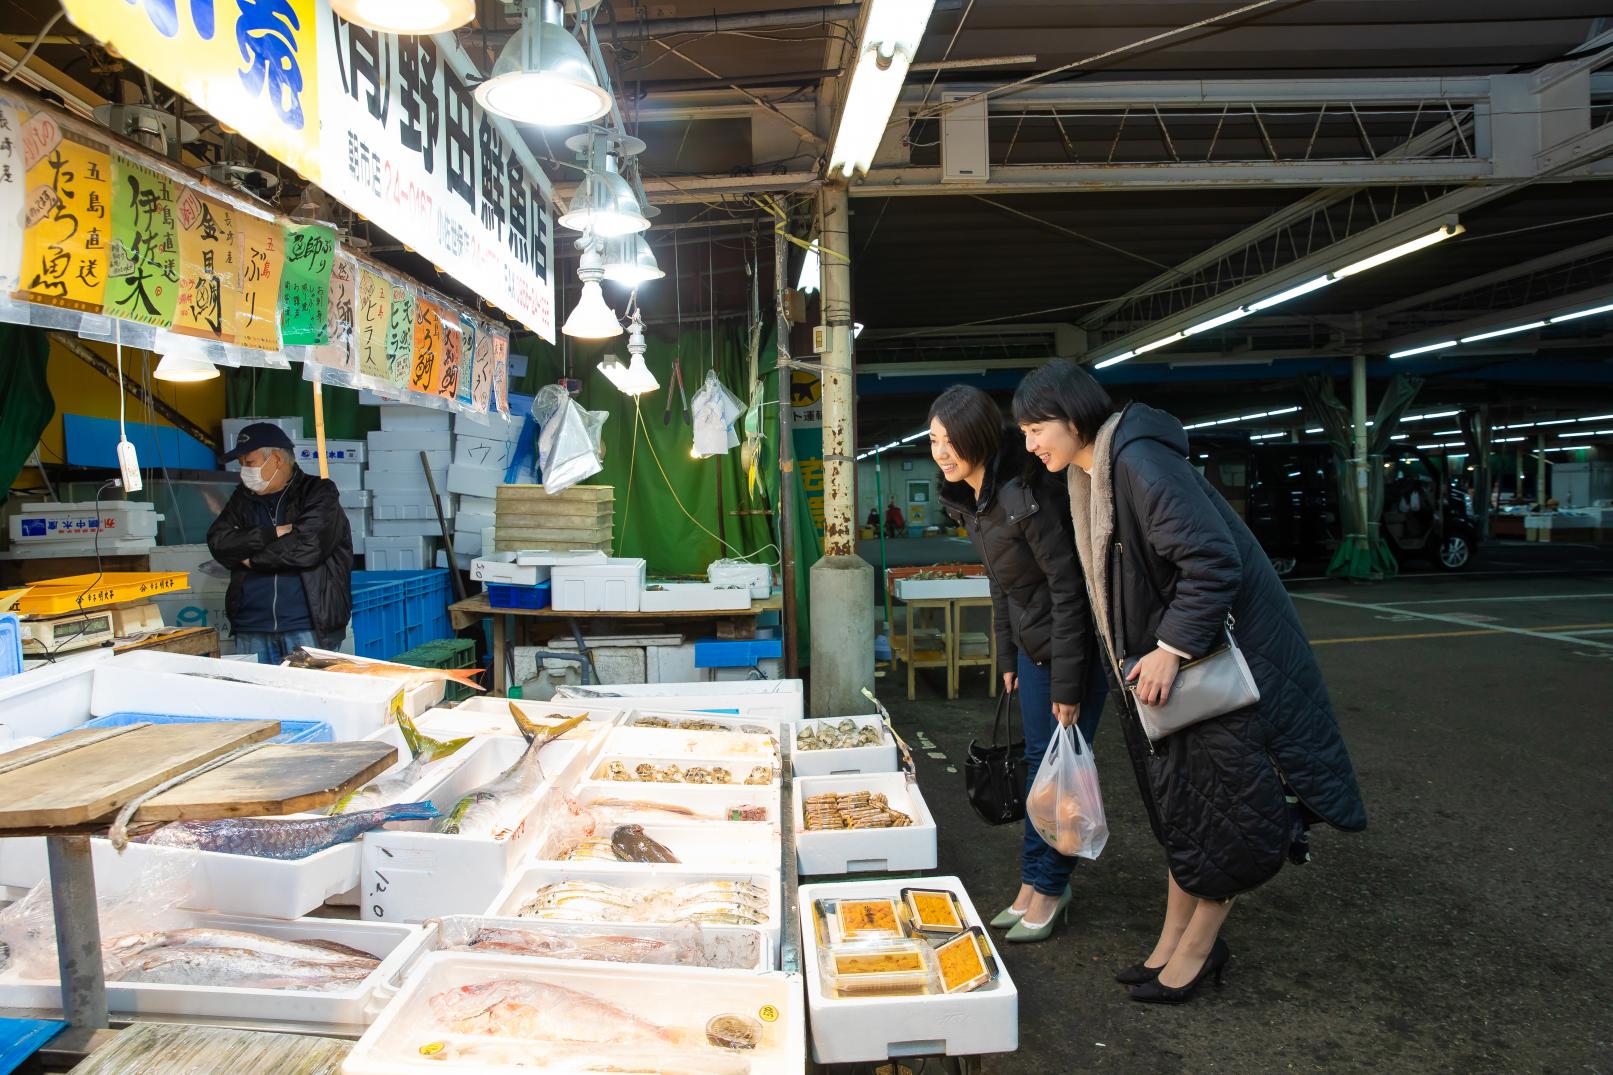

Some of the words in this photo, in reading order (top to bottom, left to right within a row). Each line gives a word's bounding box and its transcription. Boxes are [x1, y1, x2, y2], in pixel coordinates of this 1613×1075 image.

[348, 128, 381, 198] 朝市店
[76, 162, 106, 287] 五島直送
[115, 174, 162, 318] 伊佐木
[158, 181, 180, 284] 五島直送
[189, 201, 226, 337] 金目鯛
[244, 247, 267, 329] ぶり
[364, 300, 377, 366] ヒラス
